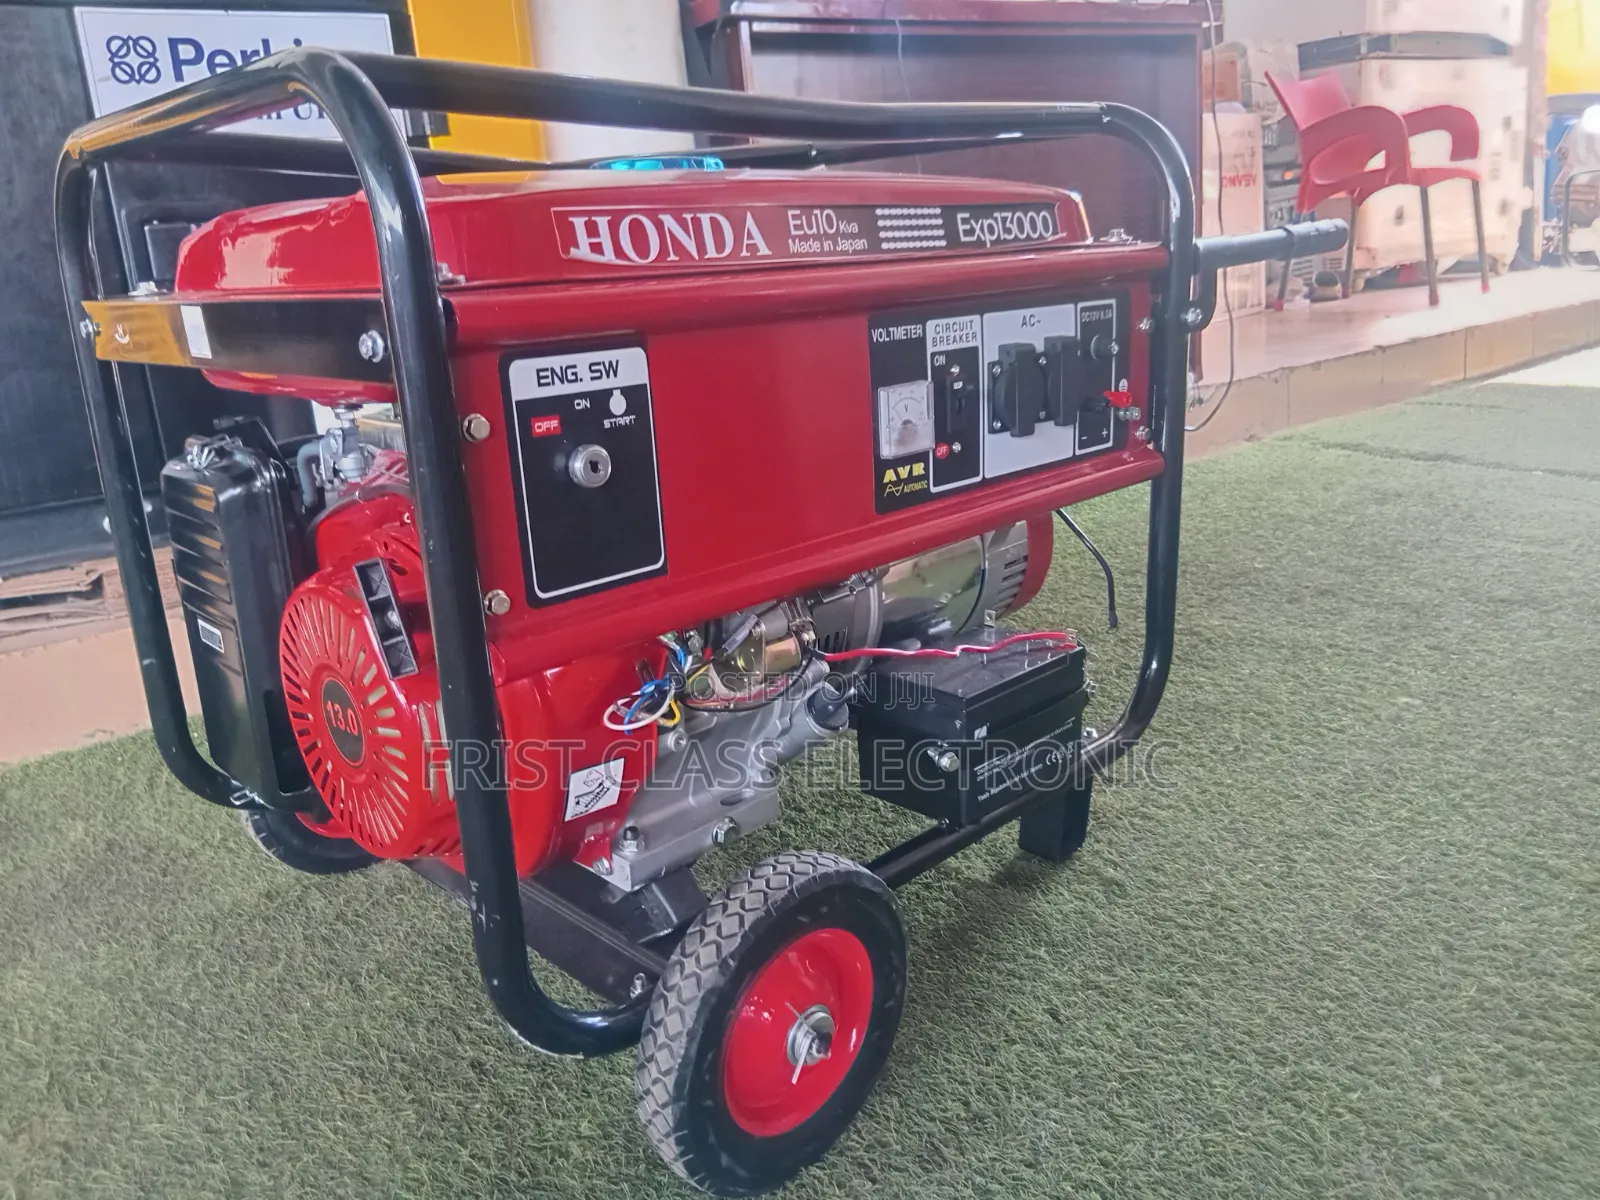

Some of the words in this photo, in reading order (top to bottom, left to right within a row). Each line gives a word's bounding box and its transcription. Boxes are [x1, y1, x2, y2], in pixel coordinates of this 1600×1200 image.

[568, 211, 772, 264] HONDA
[788, 238, 821, 254] Made
[823, 237, 834, 251] in
[835, 237, 867, 253] Japan
[871, 324, 923, 343] VOLTMETER
[934, 320, 974, 336] CIRCUIT
[932, 332, 977, 347] BREAKER
[934, 355, 946, 367] ON
[536, 364, 584, 388] ENG.
[588, 359, 619, 381] SW
[574, 398, 590, 410] ON
[535, 420, 559, 433] OFF
[603, 415, 636, 429] START
[936, 446, 947, 456] OFF
[883, 462, 925, 483] AVR
